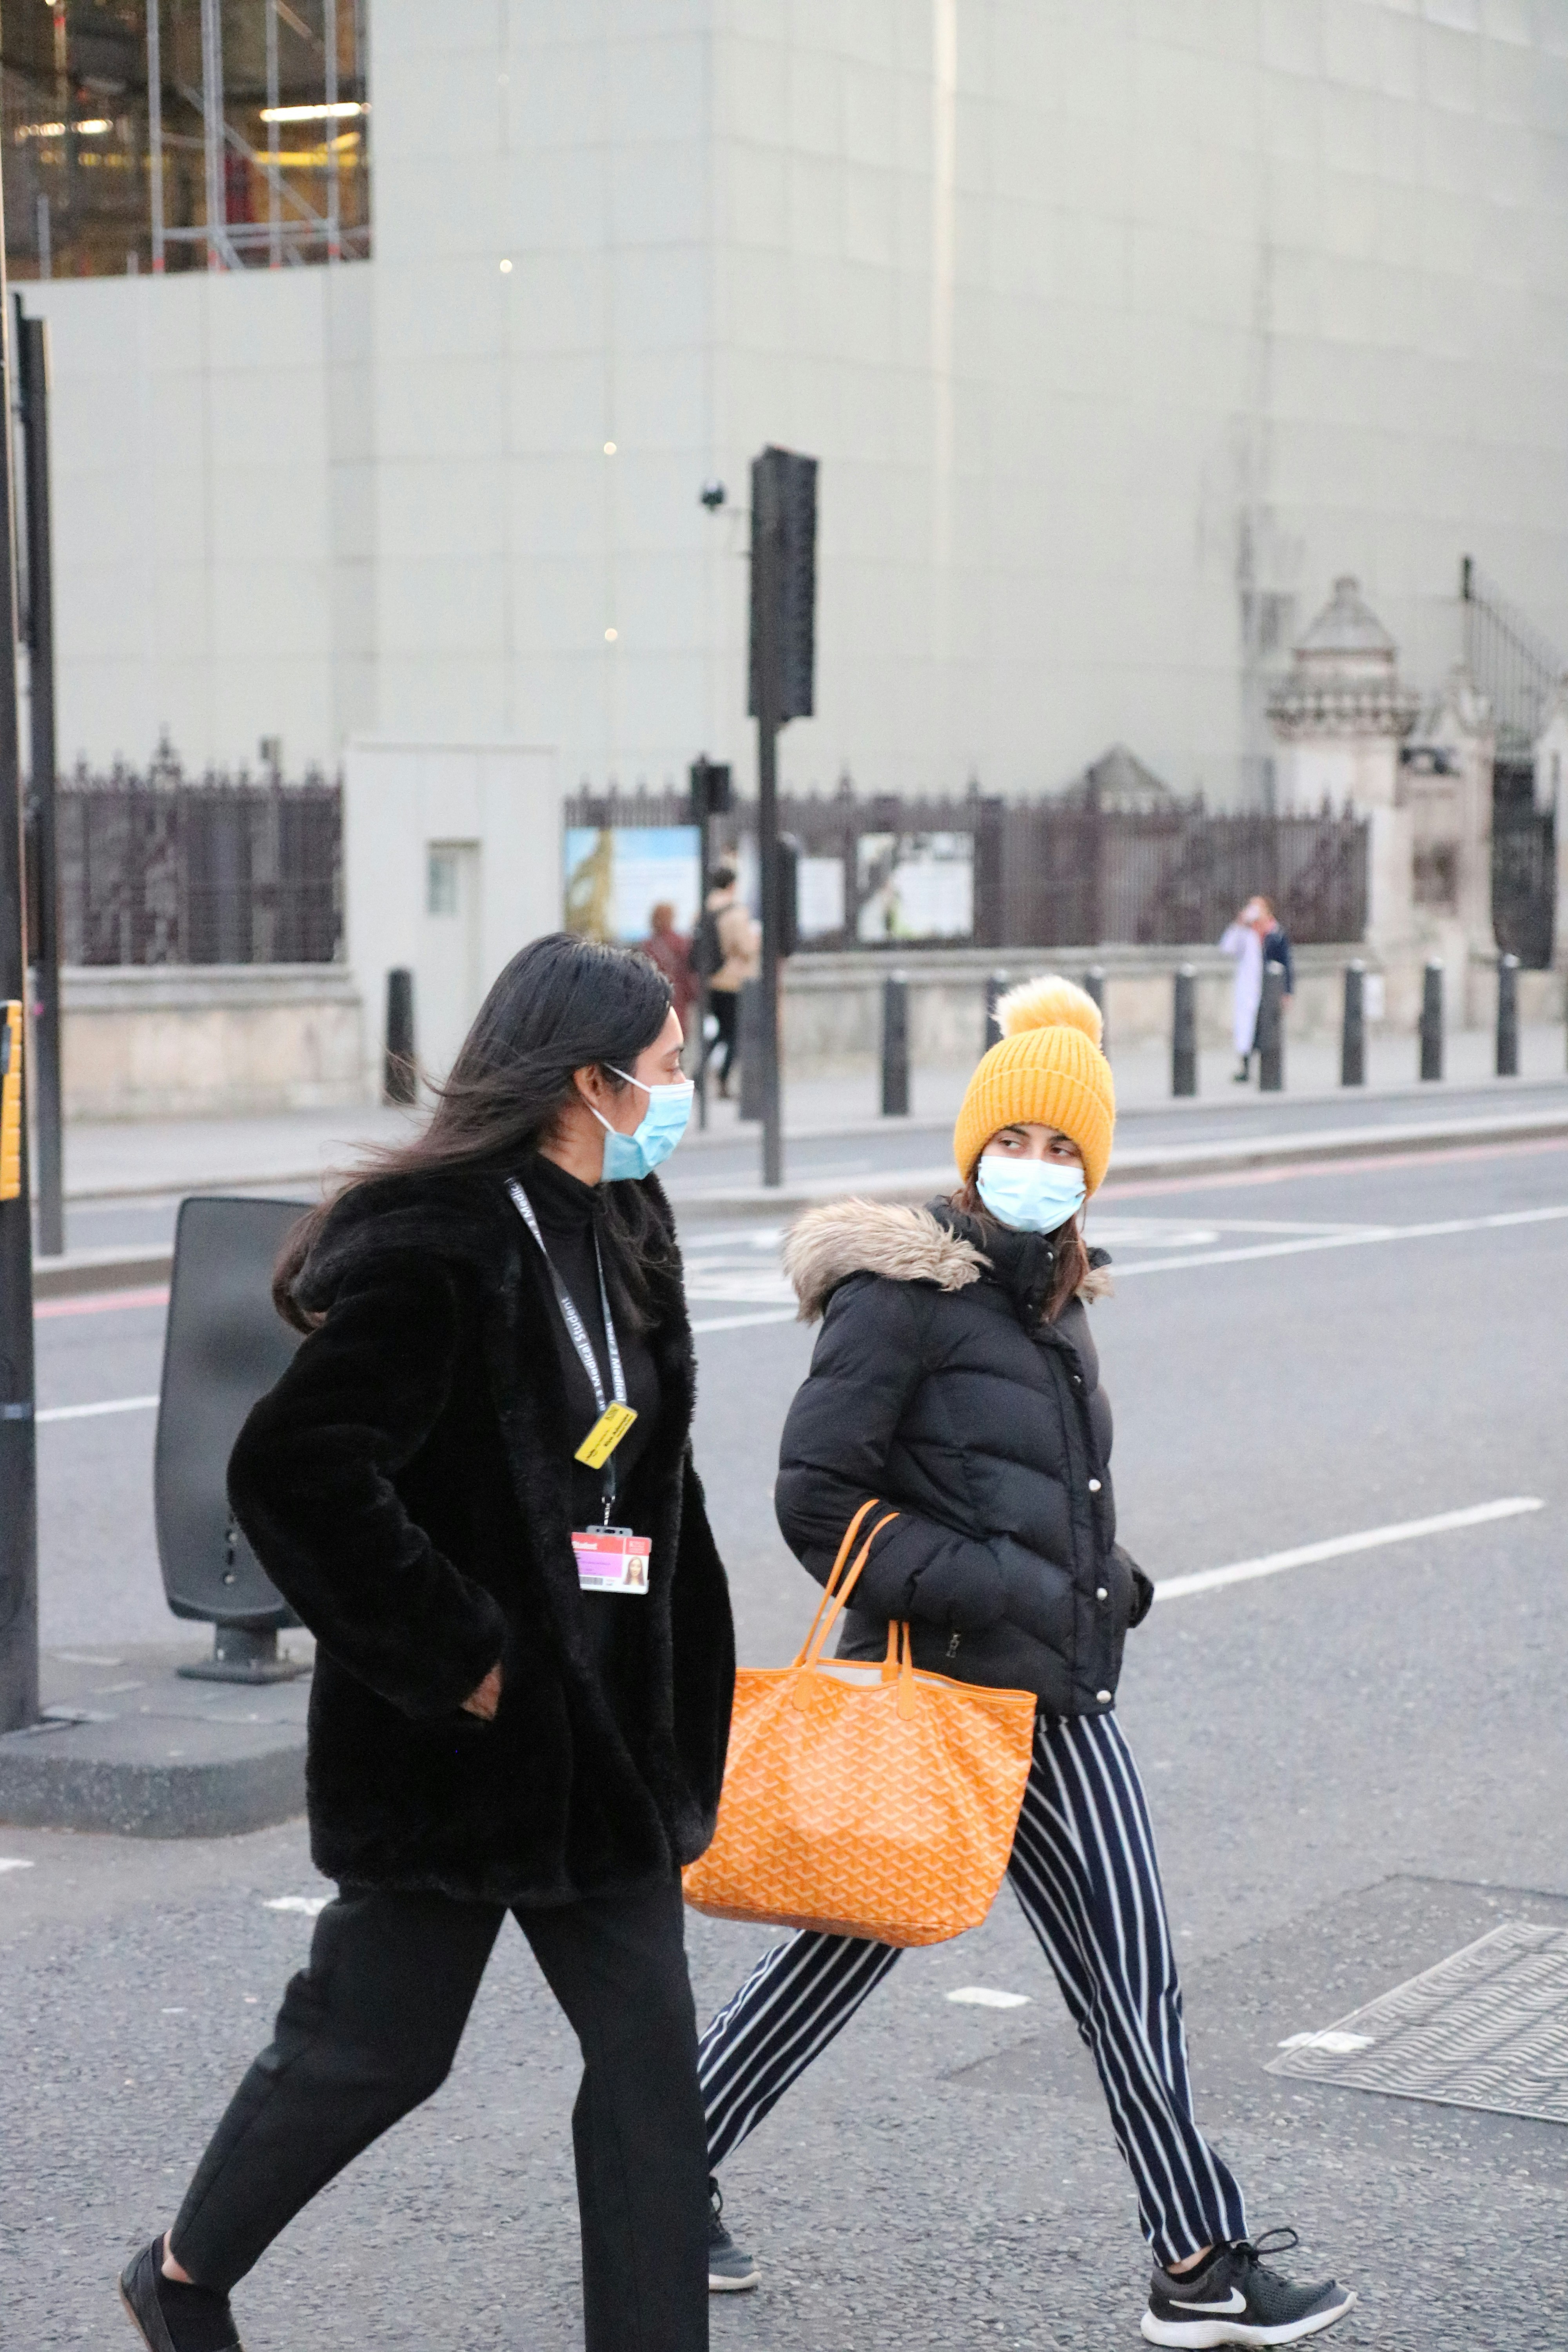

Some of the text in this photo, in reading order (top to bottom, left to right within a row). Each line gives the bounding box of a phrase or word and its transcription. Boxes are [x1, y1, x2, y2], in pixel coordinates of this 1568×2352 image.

[561, 1297, 586, 1341] Student
[577, 1343, 601, 1387] Medical
[611, 1358, 626, 1401] Medical
